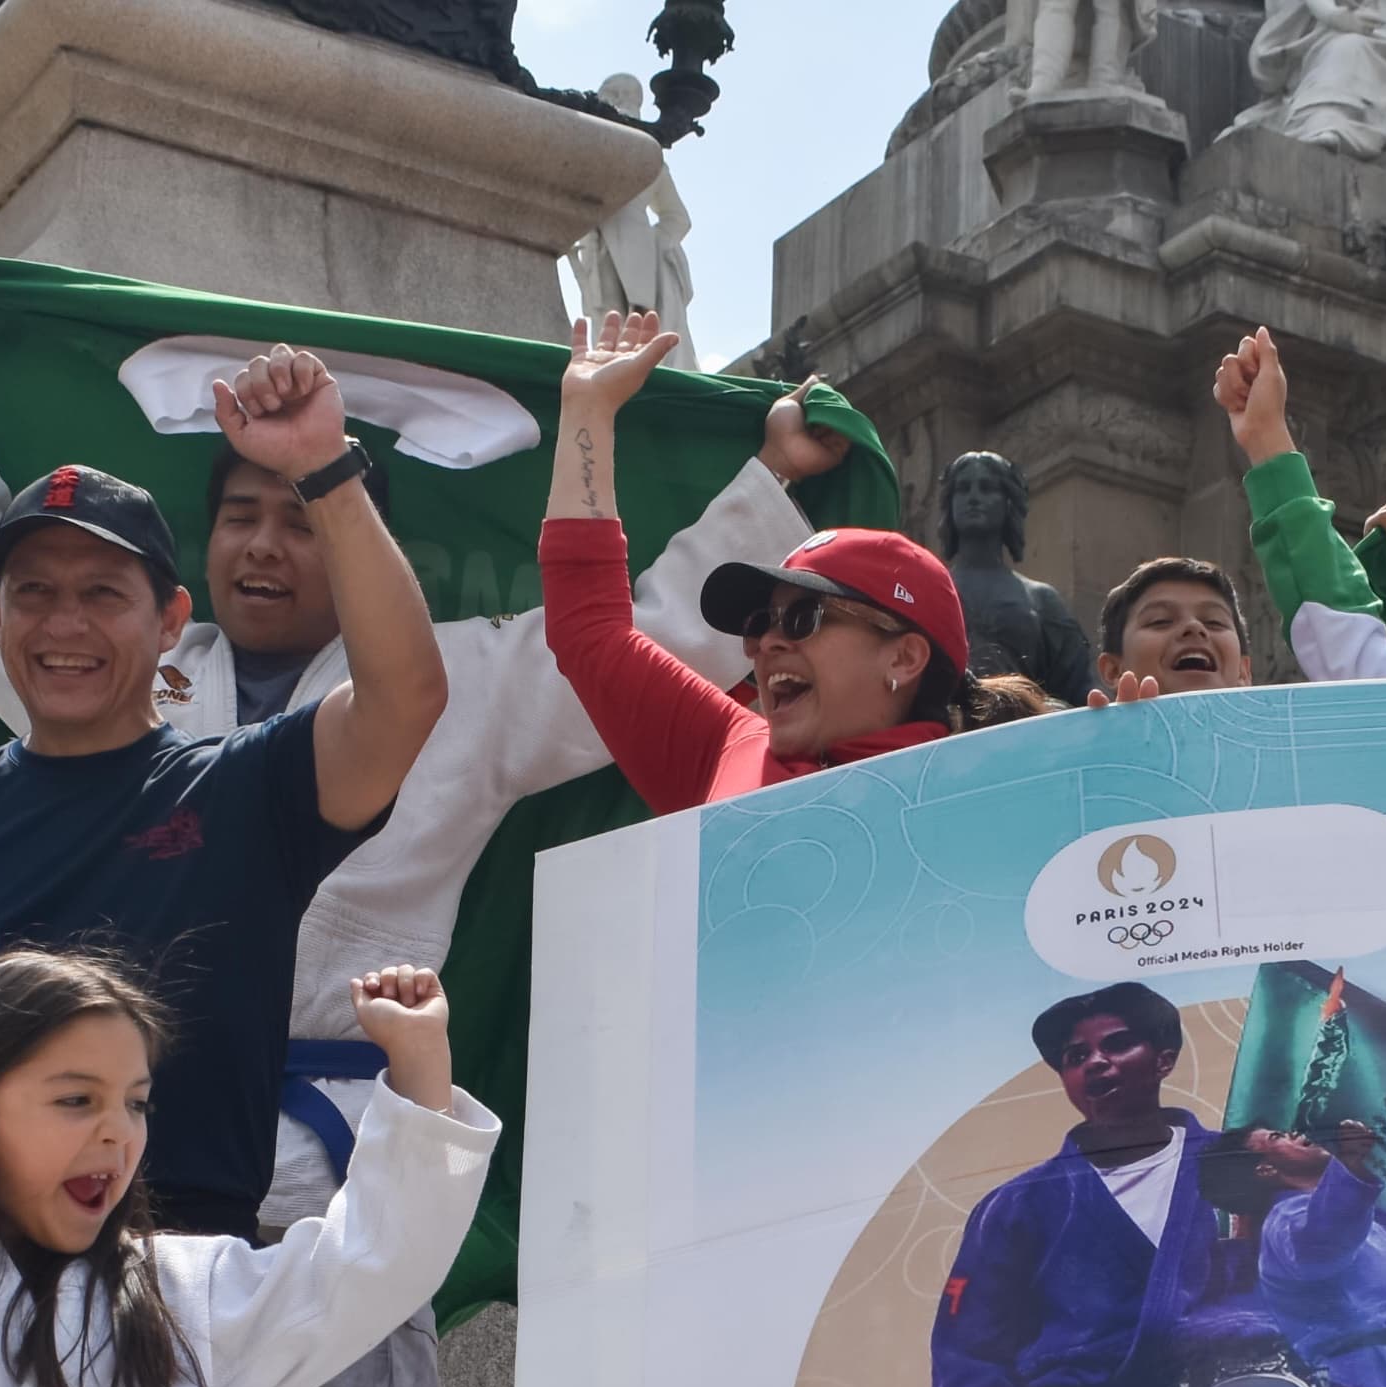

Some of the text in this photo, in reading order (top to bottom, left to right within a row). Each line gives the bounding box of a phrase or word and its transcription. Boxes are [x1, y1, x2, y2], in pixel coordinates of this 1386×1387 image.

[1076, 897, 1204, 925] PARIS 2024
[1138, 941, 1305, 967] Official Media Rights Holder
